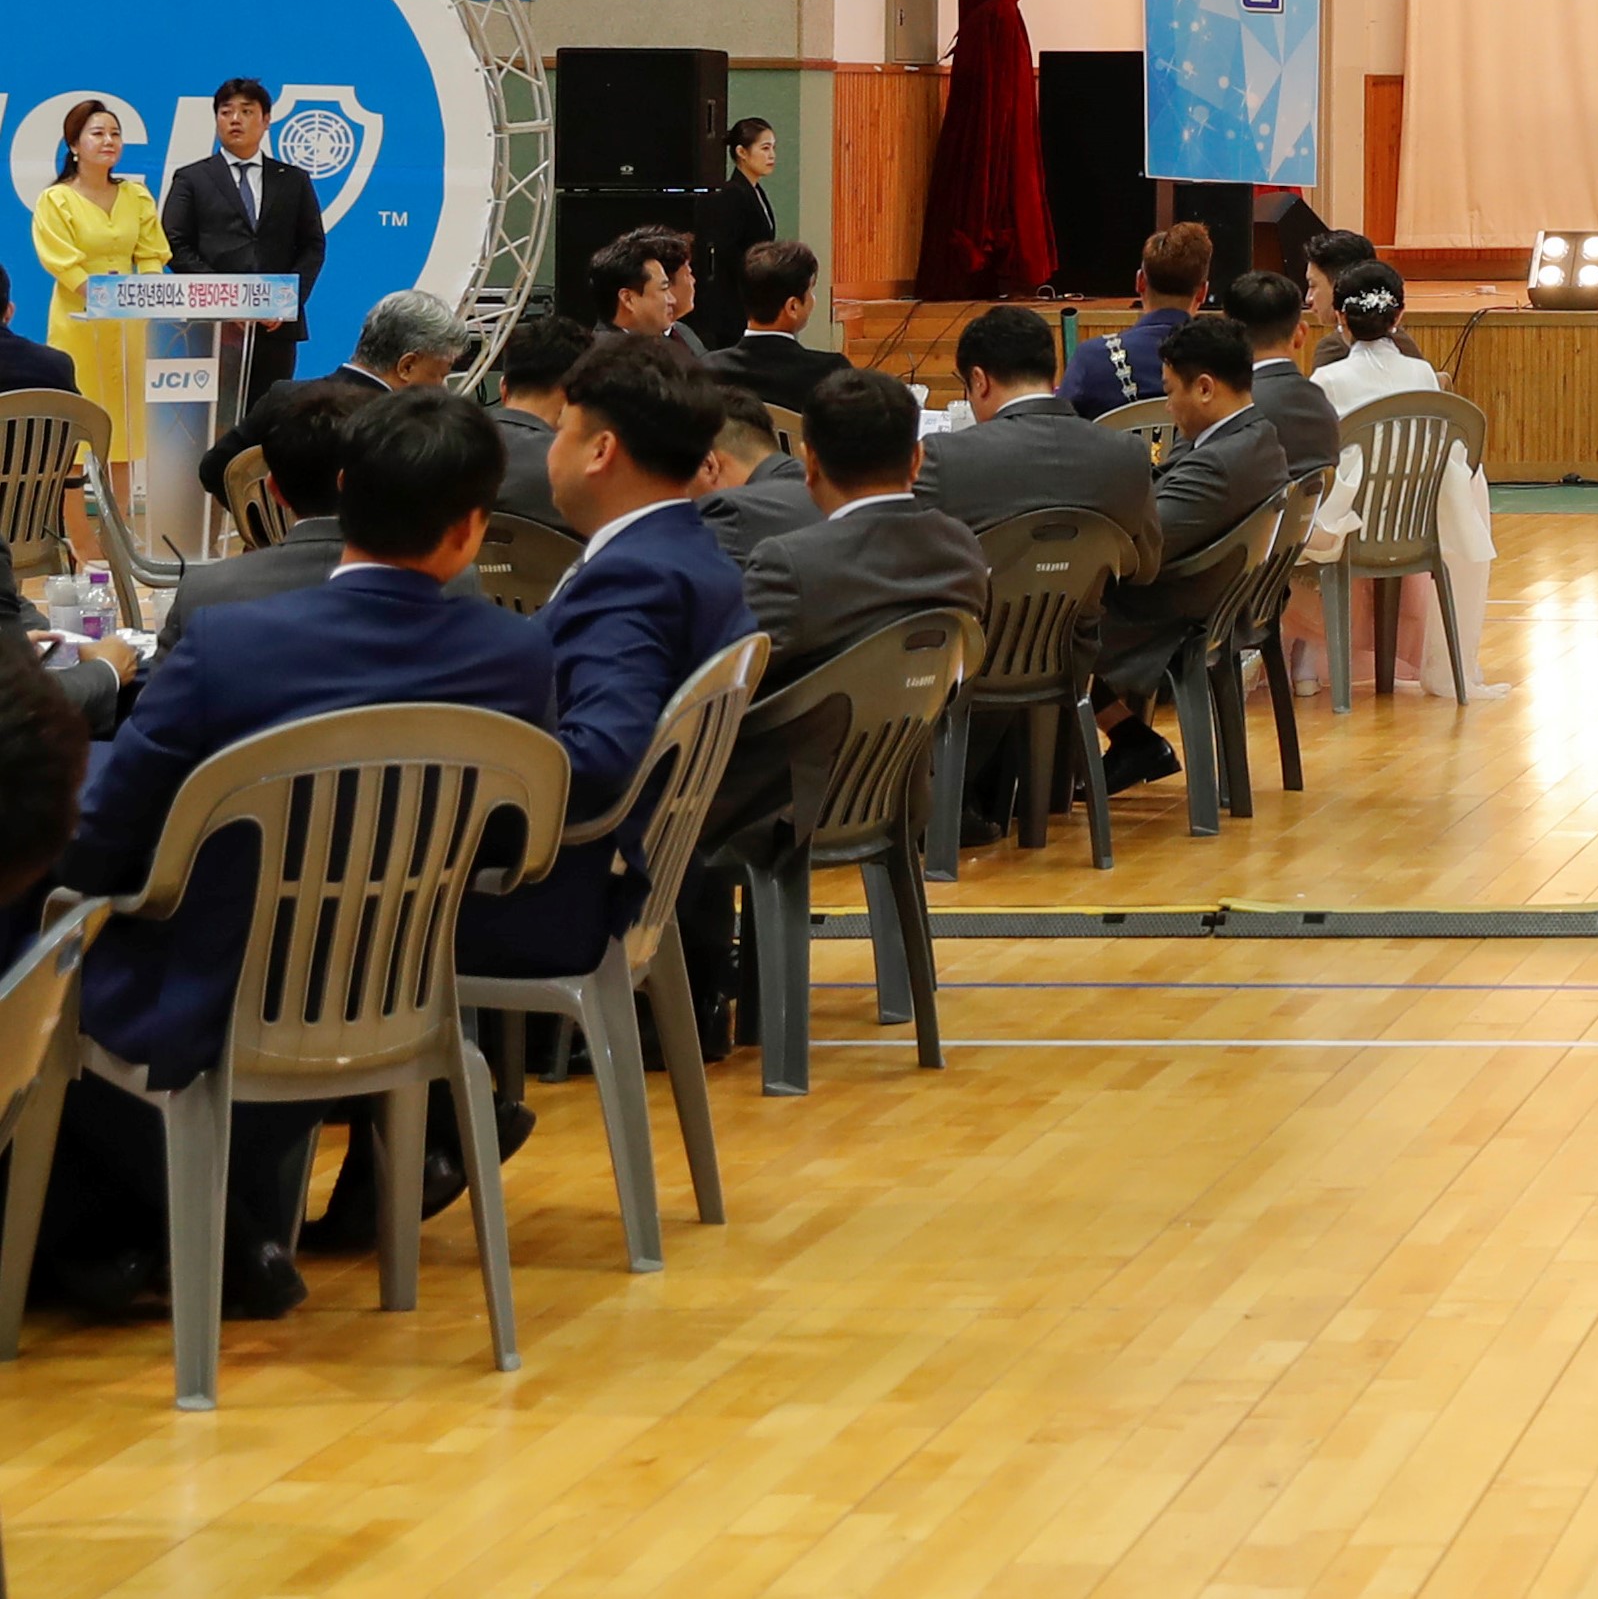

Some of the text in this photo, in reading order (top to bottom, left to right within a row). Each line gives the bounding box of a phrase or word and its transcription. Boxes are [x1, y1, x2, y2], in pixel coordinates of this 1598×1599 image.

[116, 282, 185, 307] 진도청년회의소
[187, 281, 240, 309] 창립50주년
[241, 282, 271, 308] 기념식
[151, 372, 190, 389] JCI
